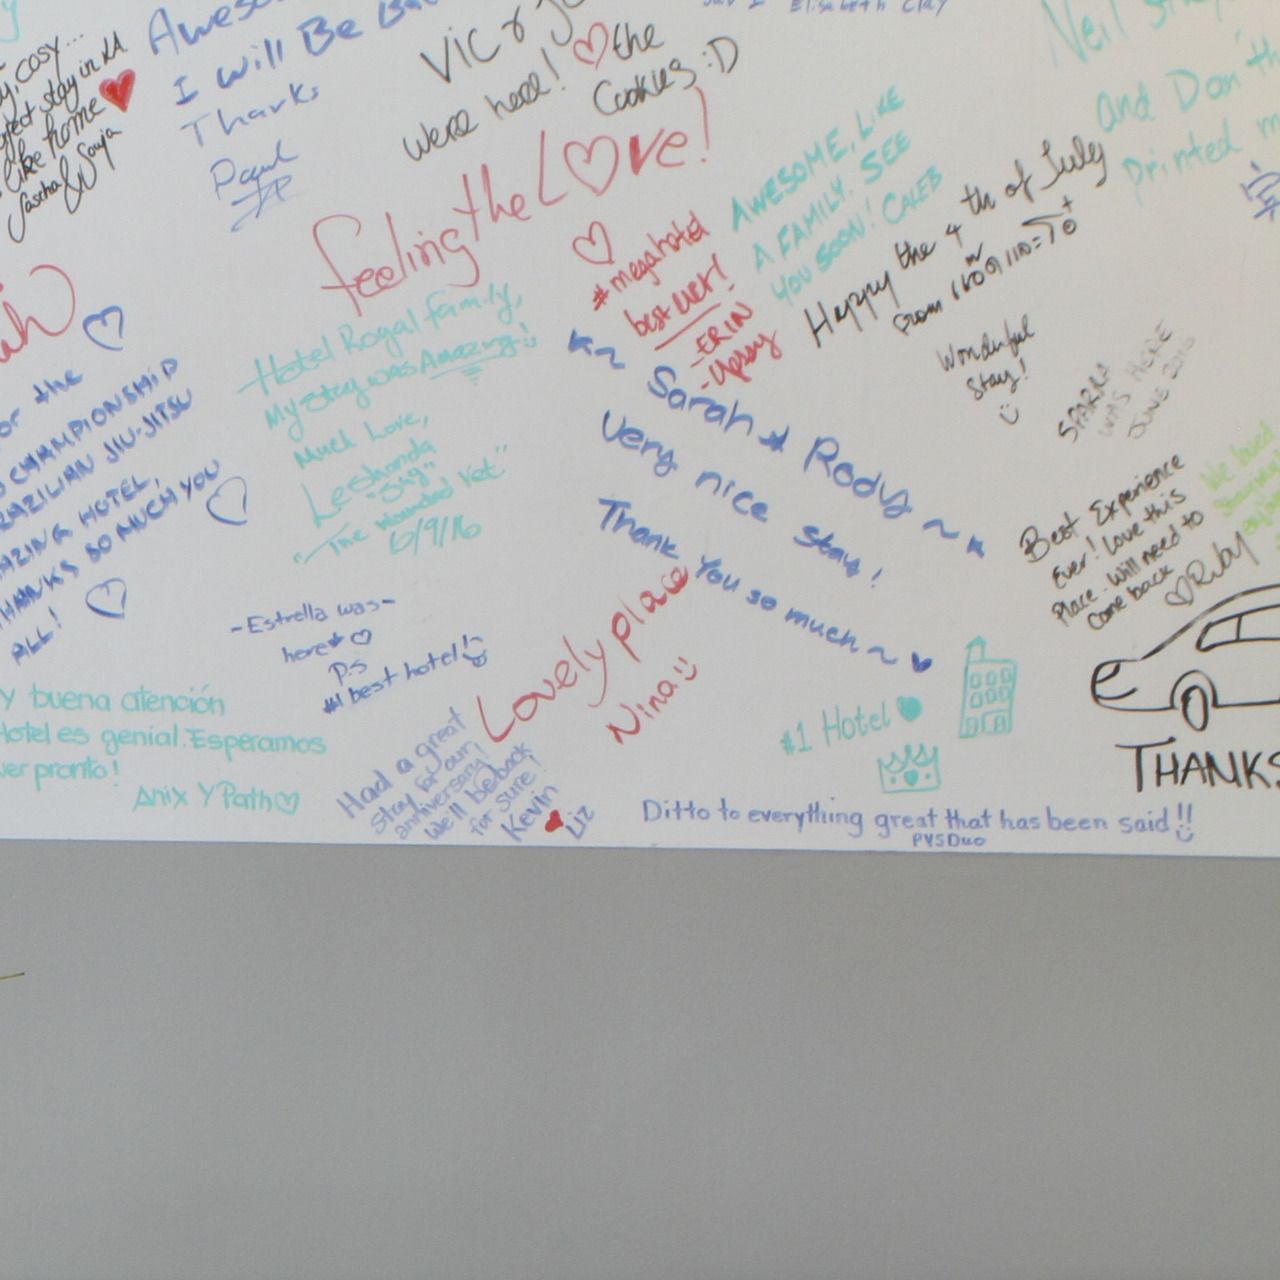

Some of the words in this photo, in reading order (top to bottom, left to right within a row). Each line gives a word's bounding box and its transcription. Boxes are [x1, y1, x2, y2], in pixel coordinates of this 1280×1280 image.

[173, 76, 199, 105] I
[298, 15, 363, 56] Be
[613, 21, 664, 61] the
[860, 129, 912, 184] SEE
[452, 163, 531, 242] the
[33, 369, 83, 405] the
[647, 364, 754, 436] Sarah
[1142, 488, 1187, 522] this
[1020, 511, 1080, 563] Best
[1142, 523, 1181, 568] need
[1181, 509, 1204, 529] to
[598, 497, 680, 559] Thank
[747, 588, 778, 611] so
[785, 607, 859, 653] much
[1127, 565, 1174, 600] back
[350, 667, 398, 704] best
[476, 634, 607, 744] Lovely
[59, 727, 91, 747] es
[822, 702, 890, 749] Hotel
[336, 770, 393, 819] Had
[396, 758, 414, 775] a
[641, 800, 711, 824] Ditto
[719, 801, 742, 821] to
[748, 801, 864, 838] everything
[874, 810, 939, 839] great
[945, 806, 992, 829] that
[999, 808, 1040, 830] has
[1046, 806, 1109, 832] been
